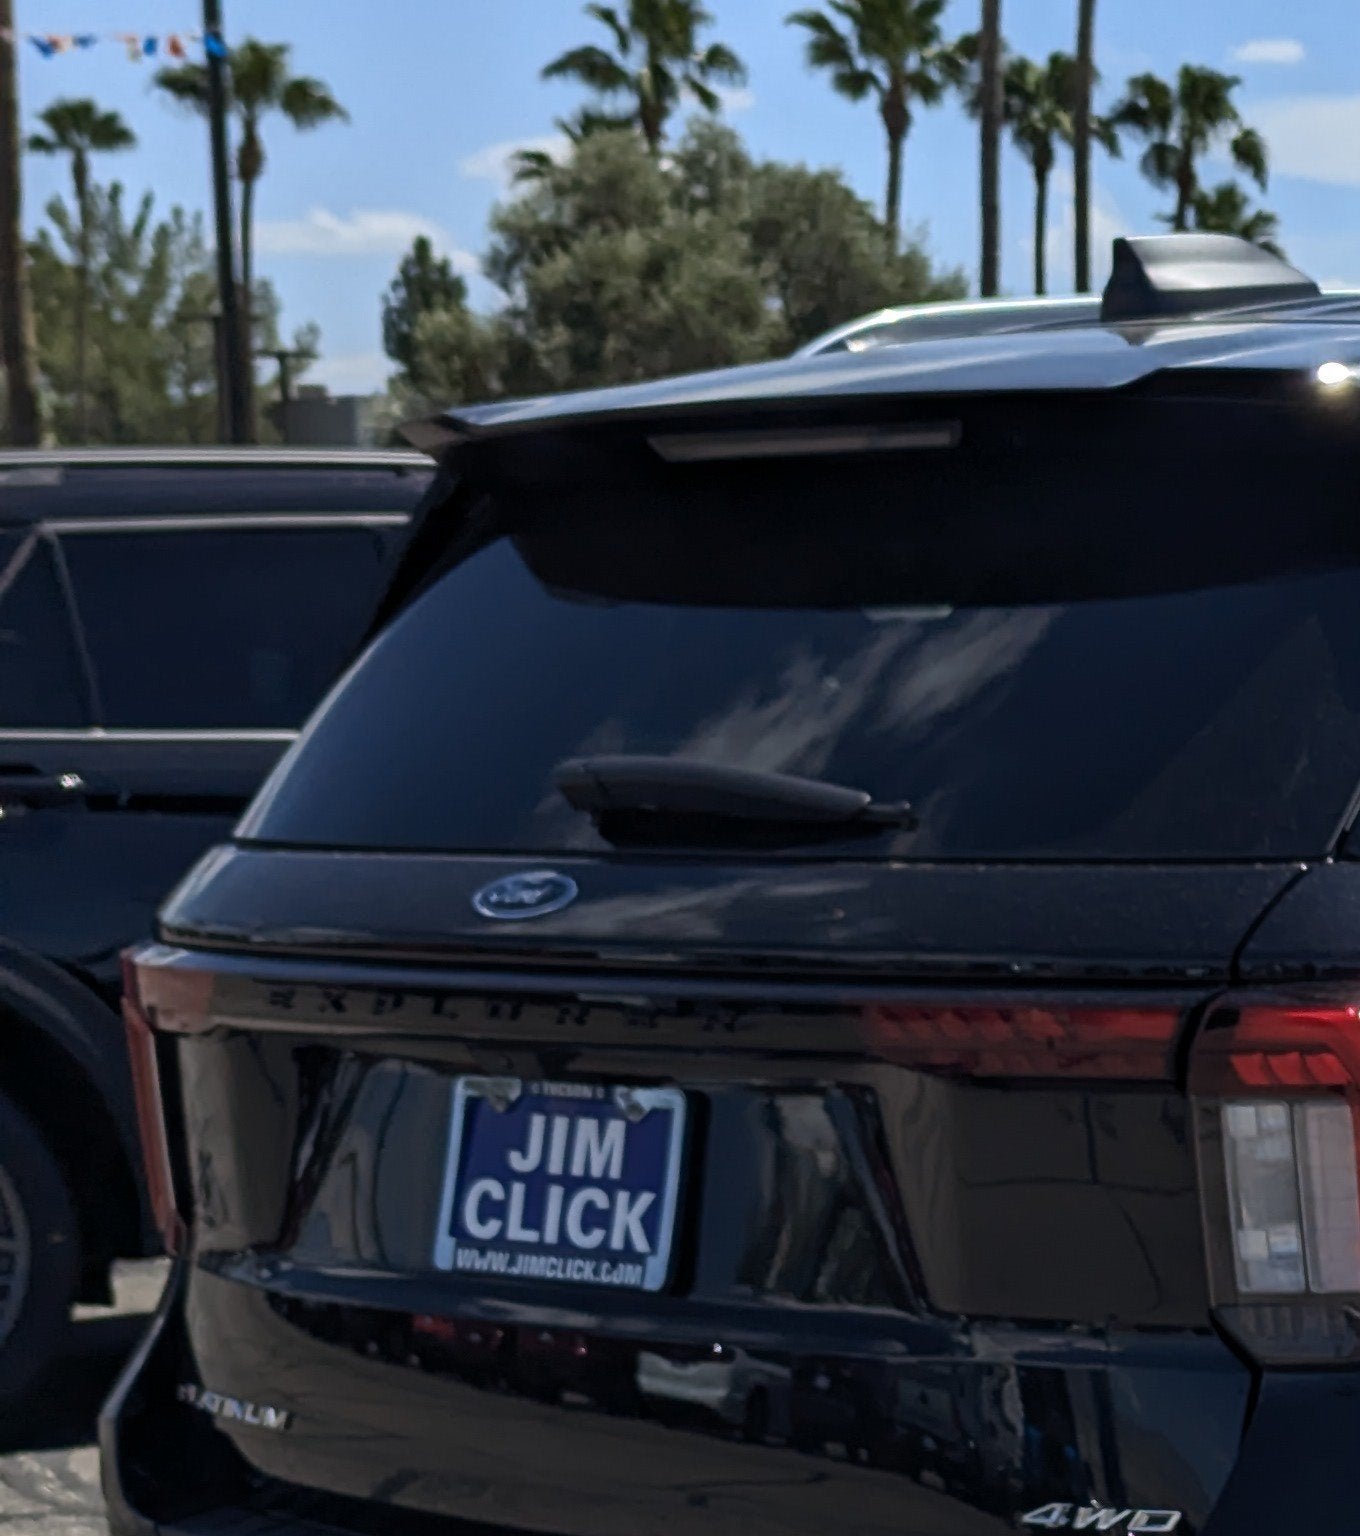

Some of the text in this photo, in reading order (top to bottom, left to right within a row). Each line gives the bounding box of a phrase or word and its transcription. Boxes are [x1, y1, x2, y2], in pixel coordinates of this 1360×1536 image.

[508, 1113, 626, 1180] JIM
[463, 1179, 657, 1253] CLICK
[1021, 1502, 1182, 1533] 4WD
